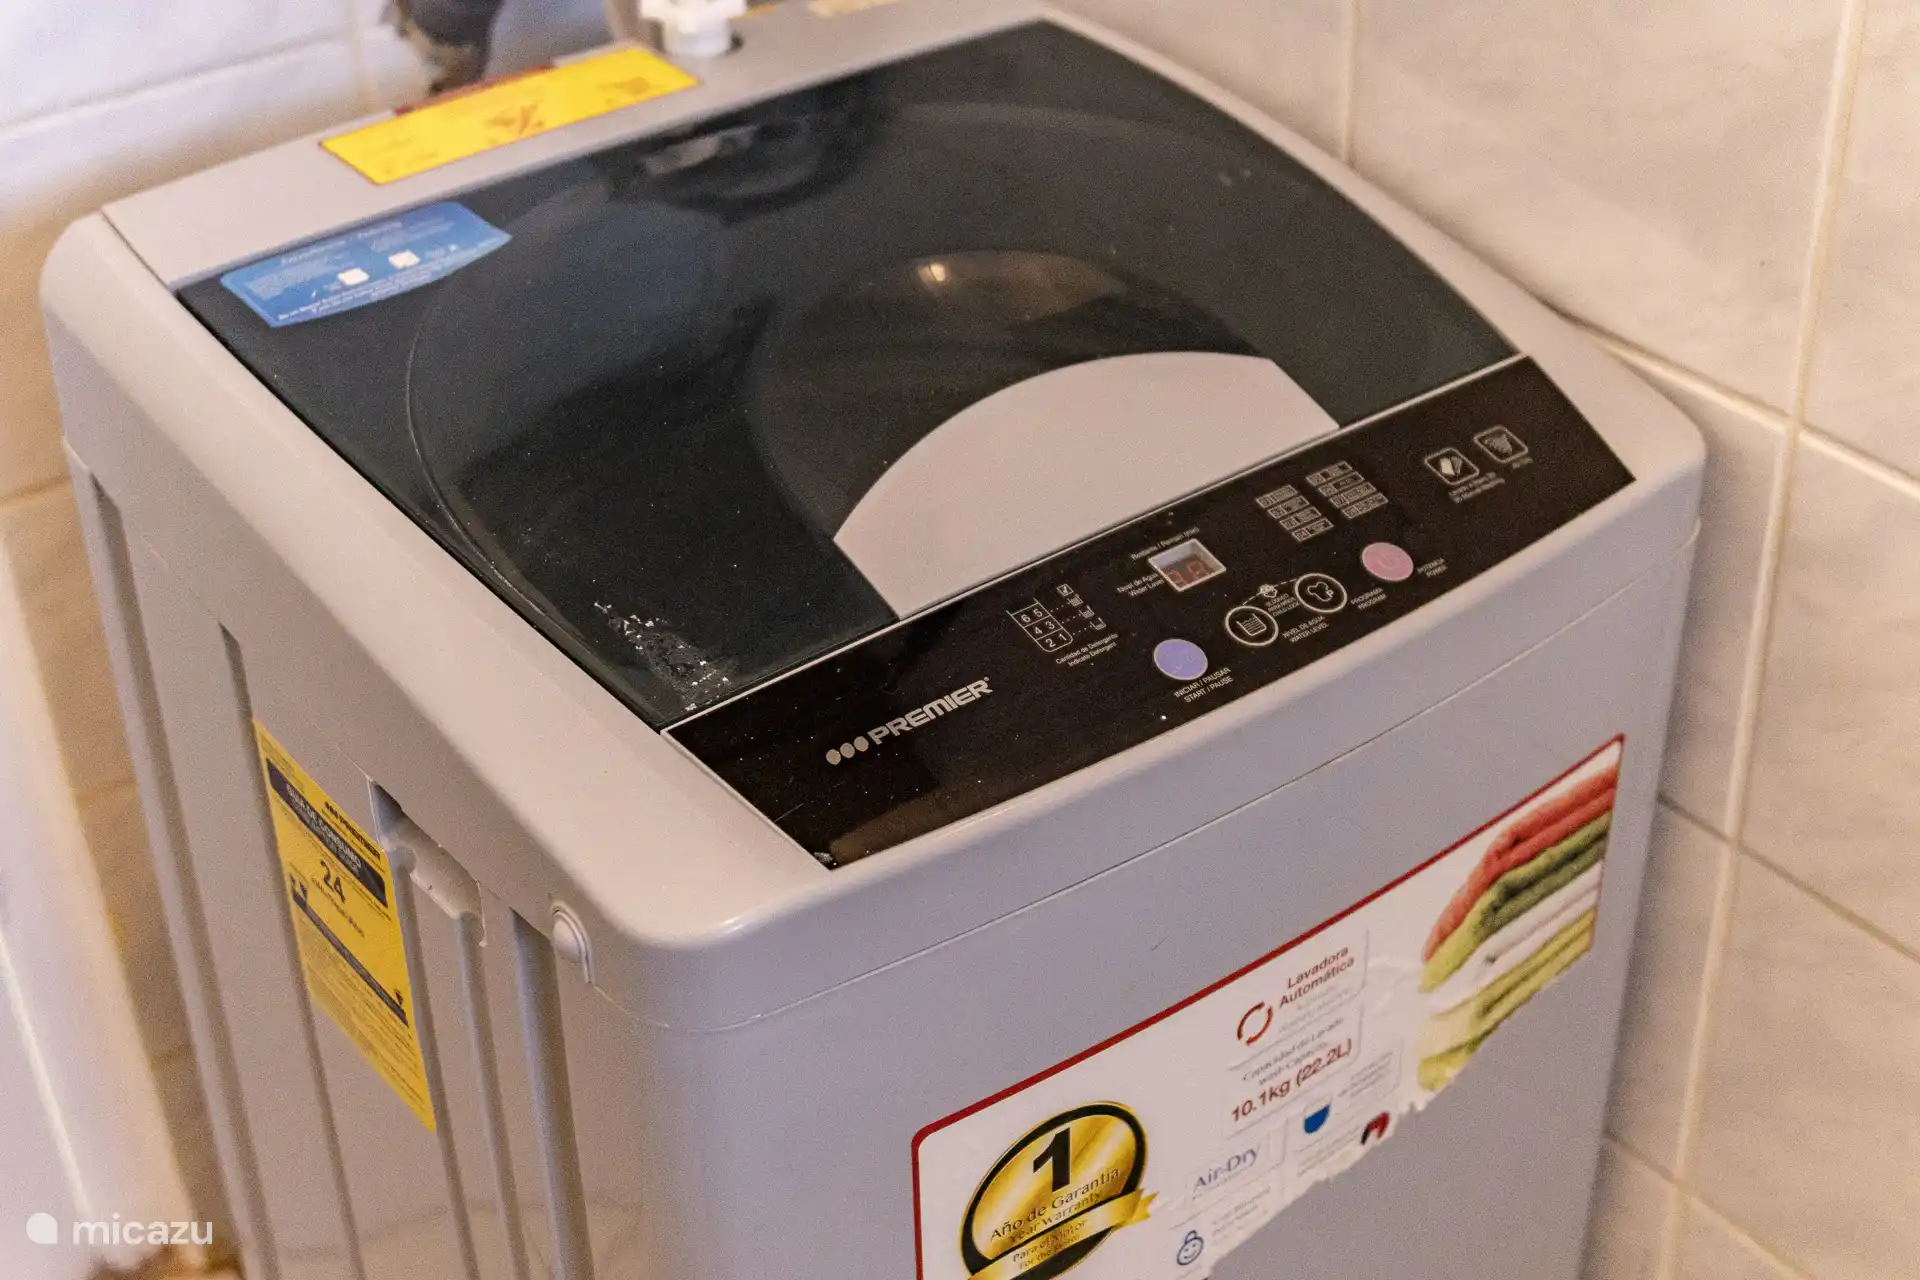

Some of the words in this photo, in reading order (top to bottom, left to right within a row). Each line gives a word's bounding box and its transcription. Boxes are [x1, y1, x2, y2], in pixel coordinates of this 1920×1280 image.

[1021, 614, 1031, 622] 6
[1033, 608, 1043, 617] 5
[1035, 626, 1043, 634] 4
[1045, 620, 1055, 630] 3
[1289, 629, 1311, 643] WATER
[1309, 621, 1330, 634] LEVEL
[1045, 638, 1056, 648] 2
[1059, 633, 1067, 641] 1
[1173, 681, 1201, 698] INICIAR
[1202, 666, 1231, 684] PAUSAR
[1183, 687, 1207, 703] START
[1208, 675, 1234, 690] PAUSE
[320, 860, 346, 904] 24
[1279, 956, 1355, 1009] Automática
[1287, 946, 1349, 989] Lavadora
[1033, 1127, 1071, 1192] 1
[1193, 1148, 1257, 1193] Air-Dry
[990, 1219, 1023, 1242] Año
[1026, 1205, 1047, 1223] de
[1051, 1167, 1120, 1209] Garantía
[1008, 1223, 1040, 1244] Year
[1013, 1242, 1037, 1263] Para
[1052, 1220, 1087, 1243] Motor
